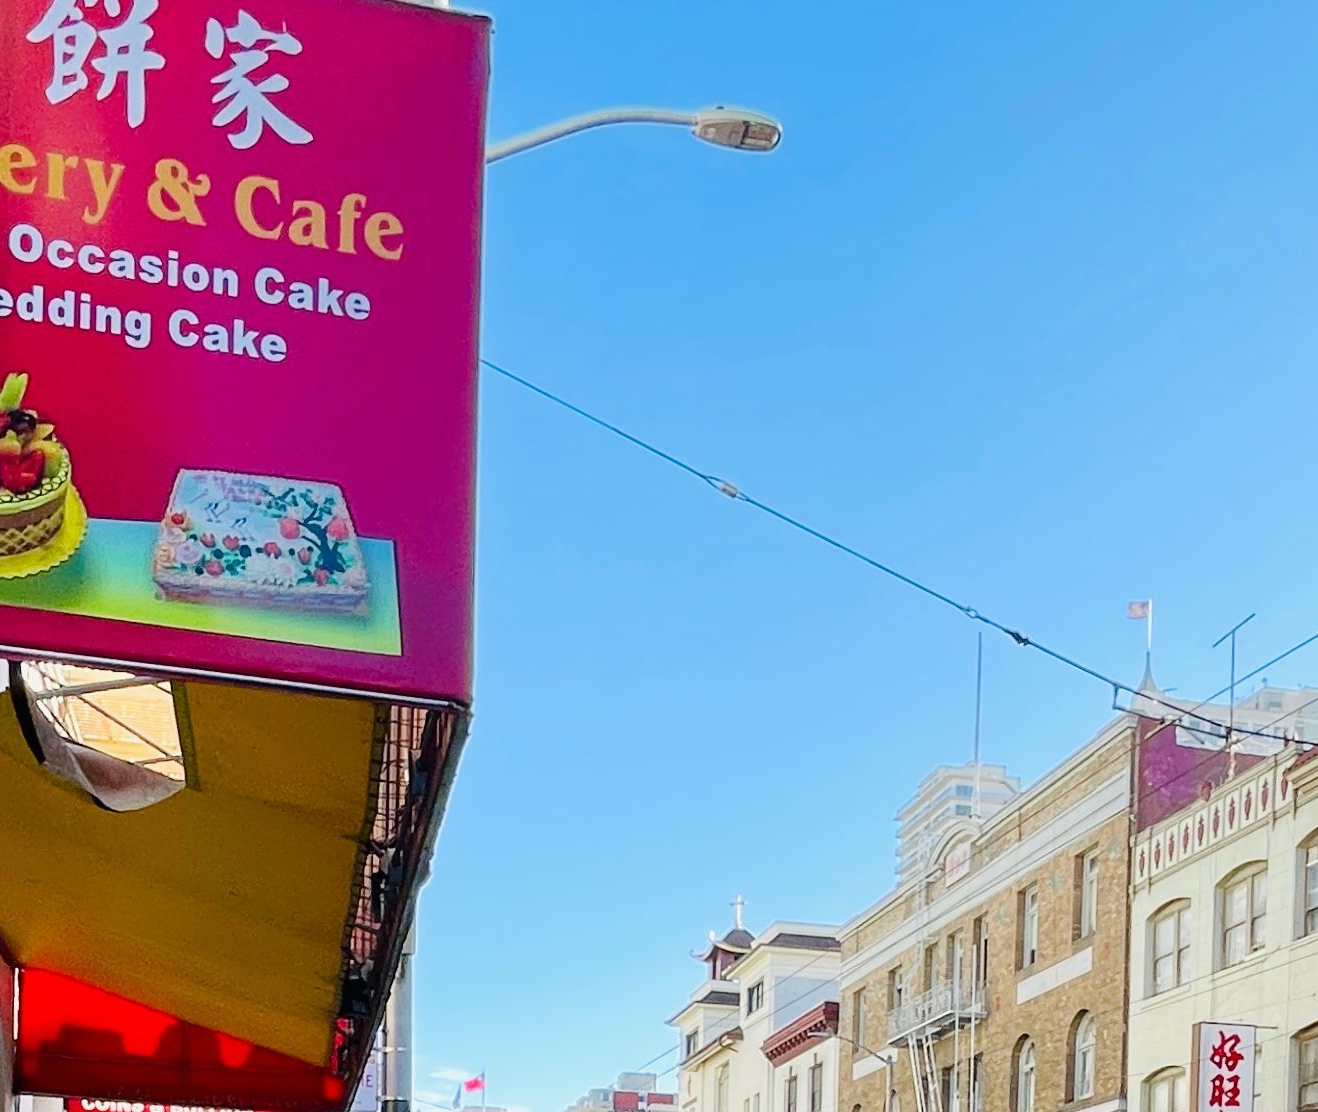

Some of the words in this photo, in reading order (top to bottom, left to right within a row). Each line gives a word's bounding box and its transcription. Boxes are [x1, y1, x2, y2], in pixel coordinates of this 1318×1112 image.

[146, 157, 212, 225] &
[234, 176, 406, 260] Cafe
[8, 223, 240, 296] Occasion
[252, 266, 372, 322] Cake
[167, 304, 289, 364] Cake
